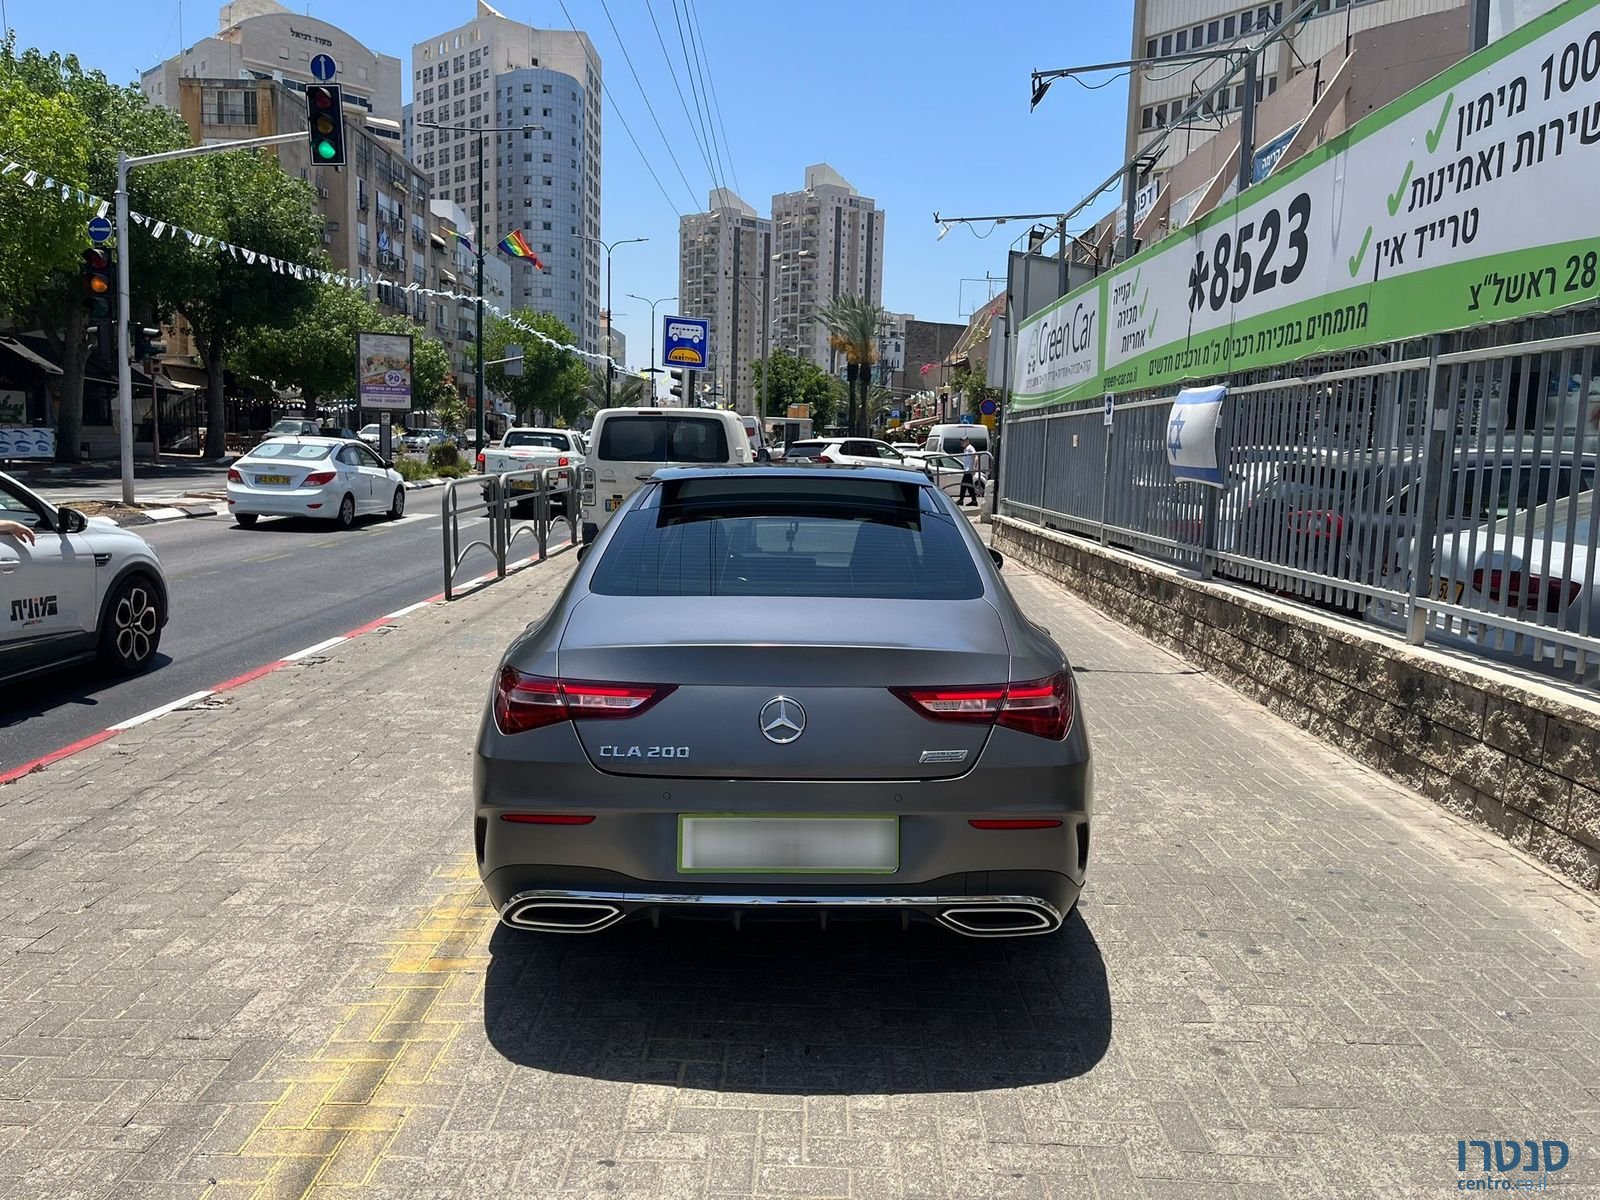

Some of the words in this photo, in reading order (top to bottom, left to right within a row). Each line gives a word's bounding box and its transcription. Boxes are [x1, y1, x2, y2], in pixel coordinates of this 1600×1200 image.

[1456, 76, 1527, 152] מימון
[1408, 141, 1505, 213] ואמינות
[1414, 206, 1479, 259] טרייד
[1373, 232, 1407, 282] אין
[1564, 251, 1597, 292] 28
[1113, 282, 1131, 305] קנייה
[1117, 305, 1138, 328] מכירה
[1306, 301, 1368, 341] מתמחים
[1038, 322, 1070, 366] Green
[1072, 302, 1096, 353] Car
[1121, 329, 1146, 353] אחריות
[1231, 335, 1254, 359] רכבי
[1255, 321, 1302, 353] במכירת
[1149, 355, 1173, 376] חדשים
[1174, 347, 1201, 370] ורכבים
[387, 374, 400, 382] 90
[1103, 365, 1138, 392] green-car.co.il
[599, 745, 642, 757] CLA
[647, 745, 690, 758] 200
